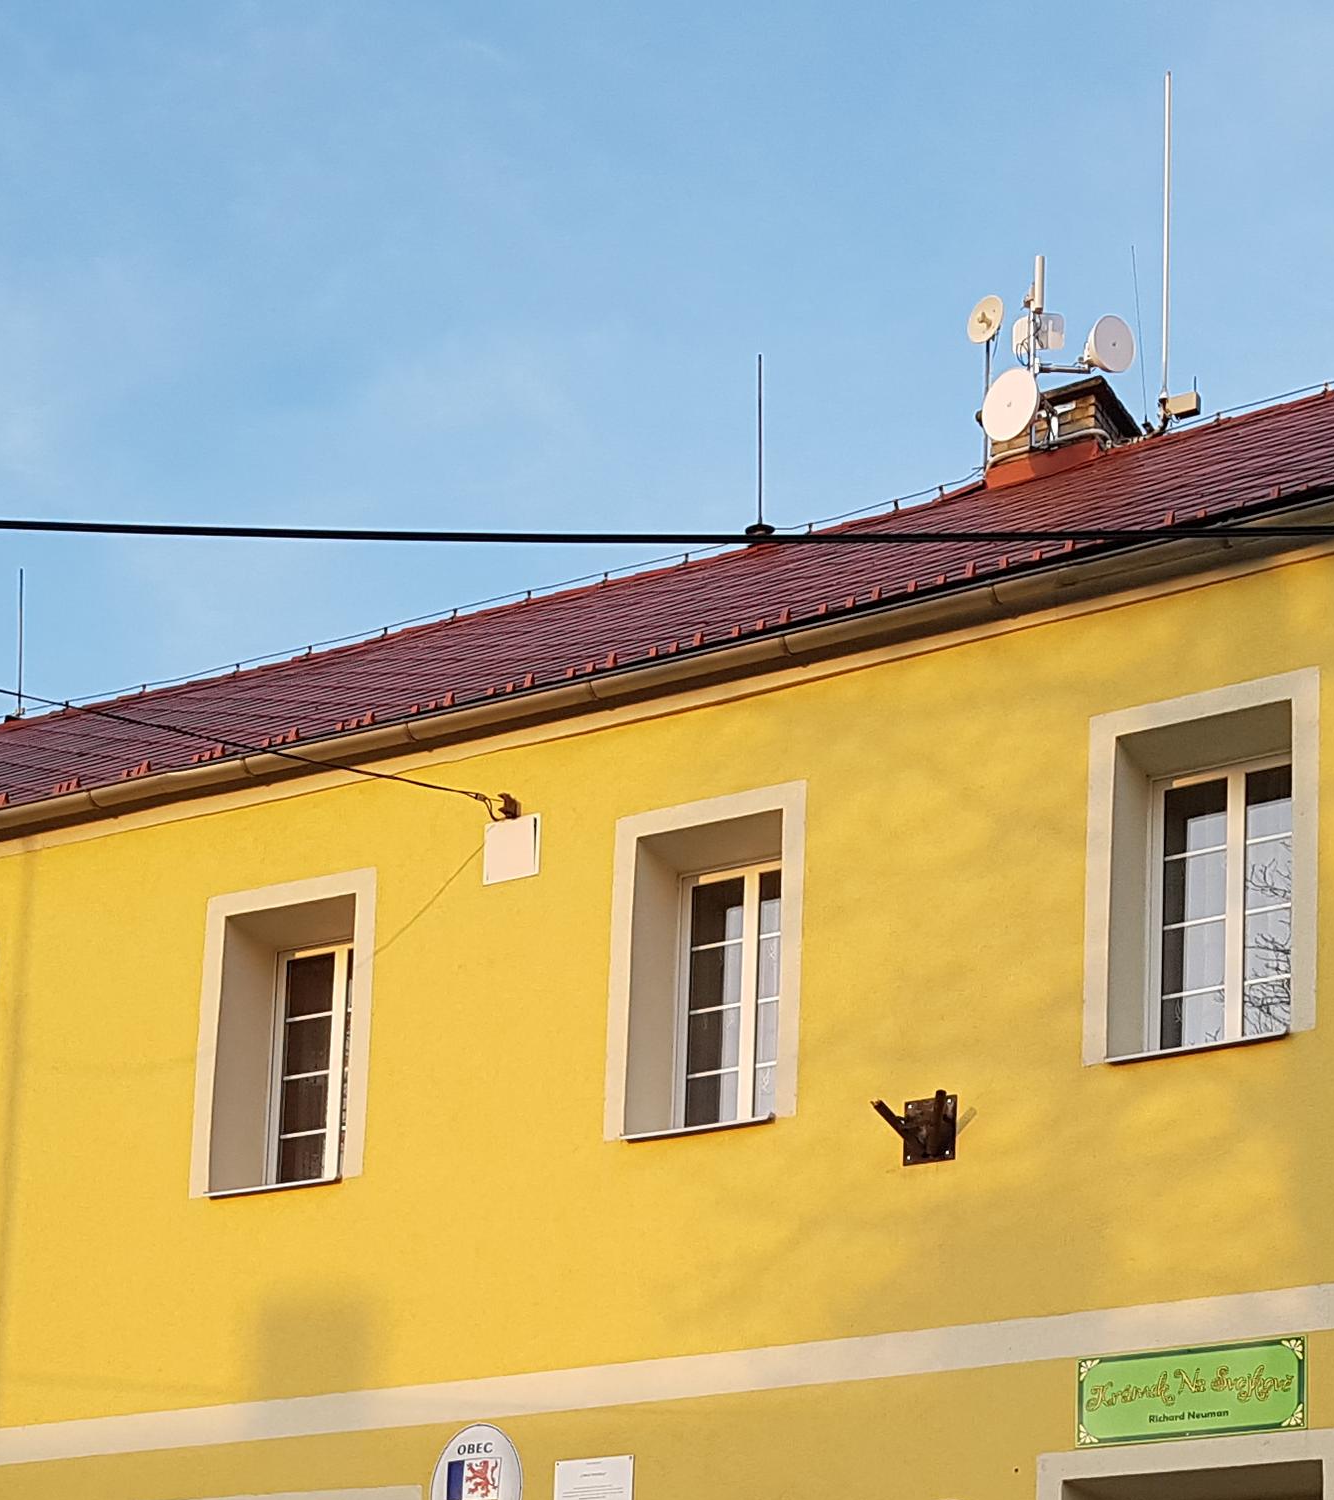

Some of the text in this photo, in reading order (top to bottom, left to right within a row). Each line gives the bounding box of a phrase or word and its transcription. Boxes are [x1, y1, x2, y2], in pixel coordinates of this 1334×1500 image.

[1174, 1368, 1206, 1394] Na
[1148, 1409, 1229, 1424] Richard Neuman
[457, 1442, 494, 1456] OBEC
